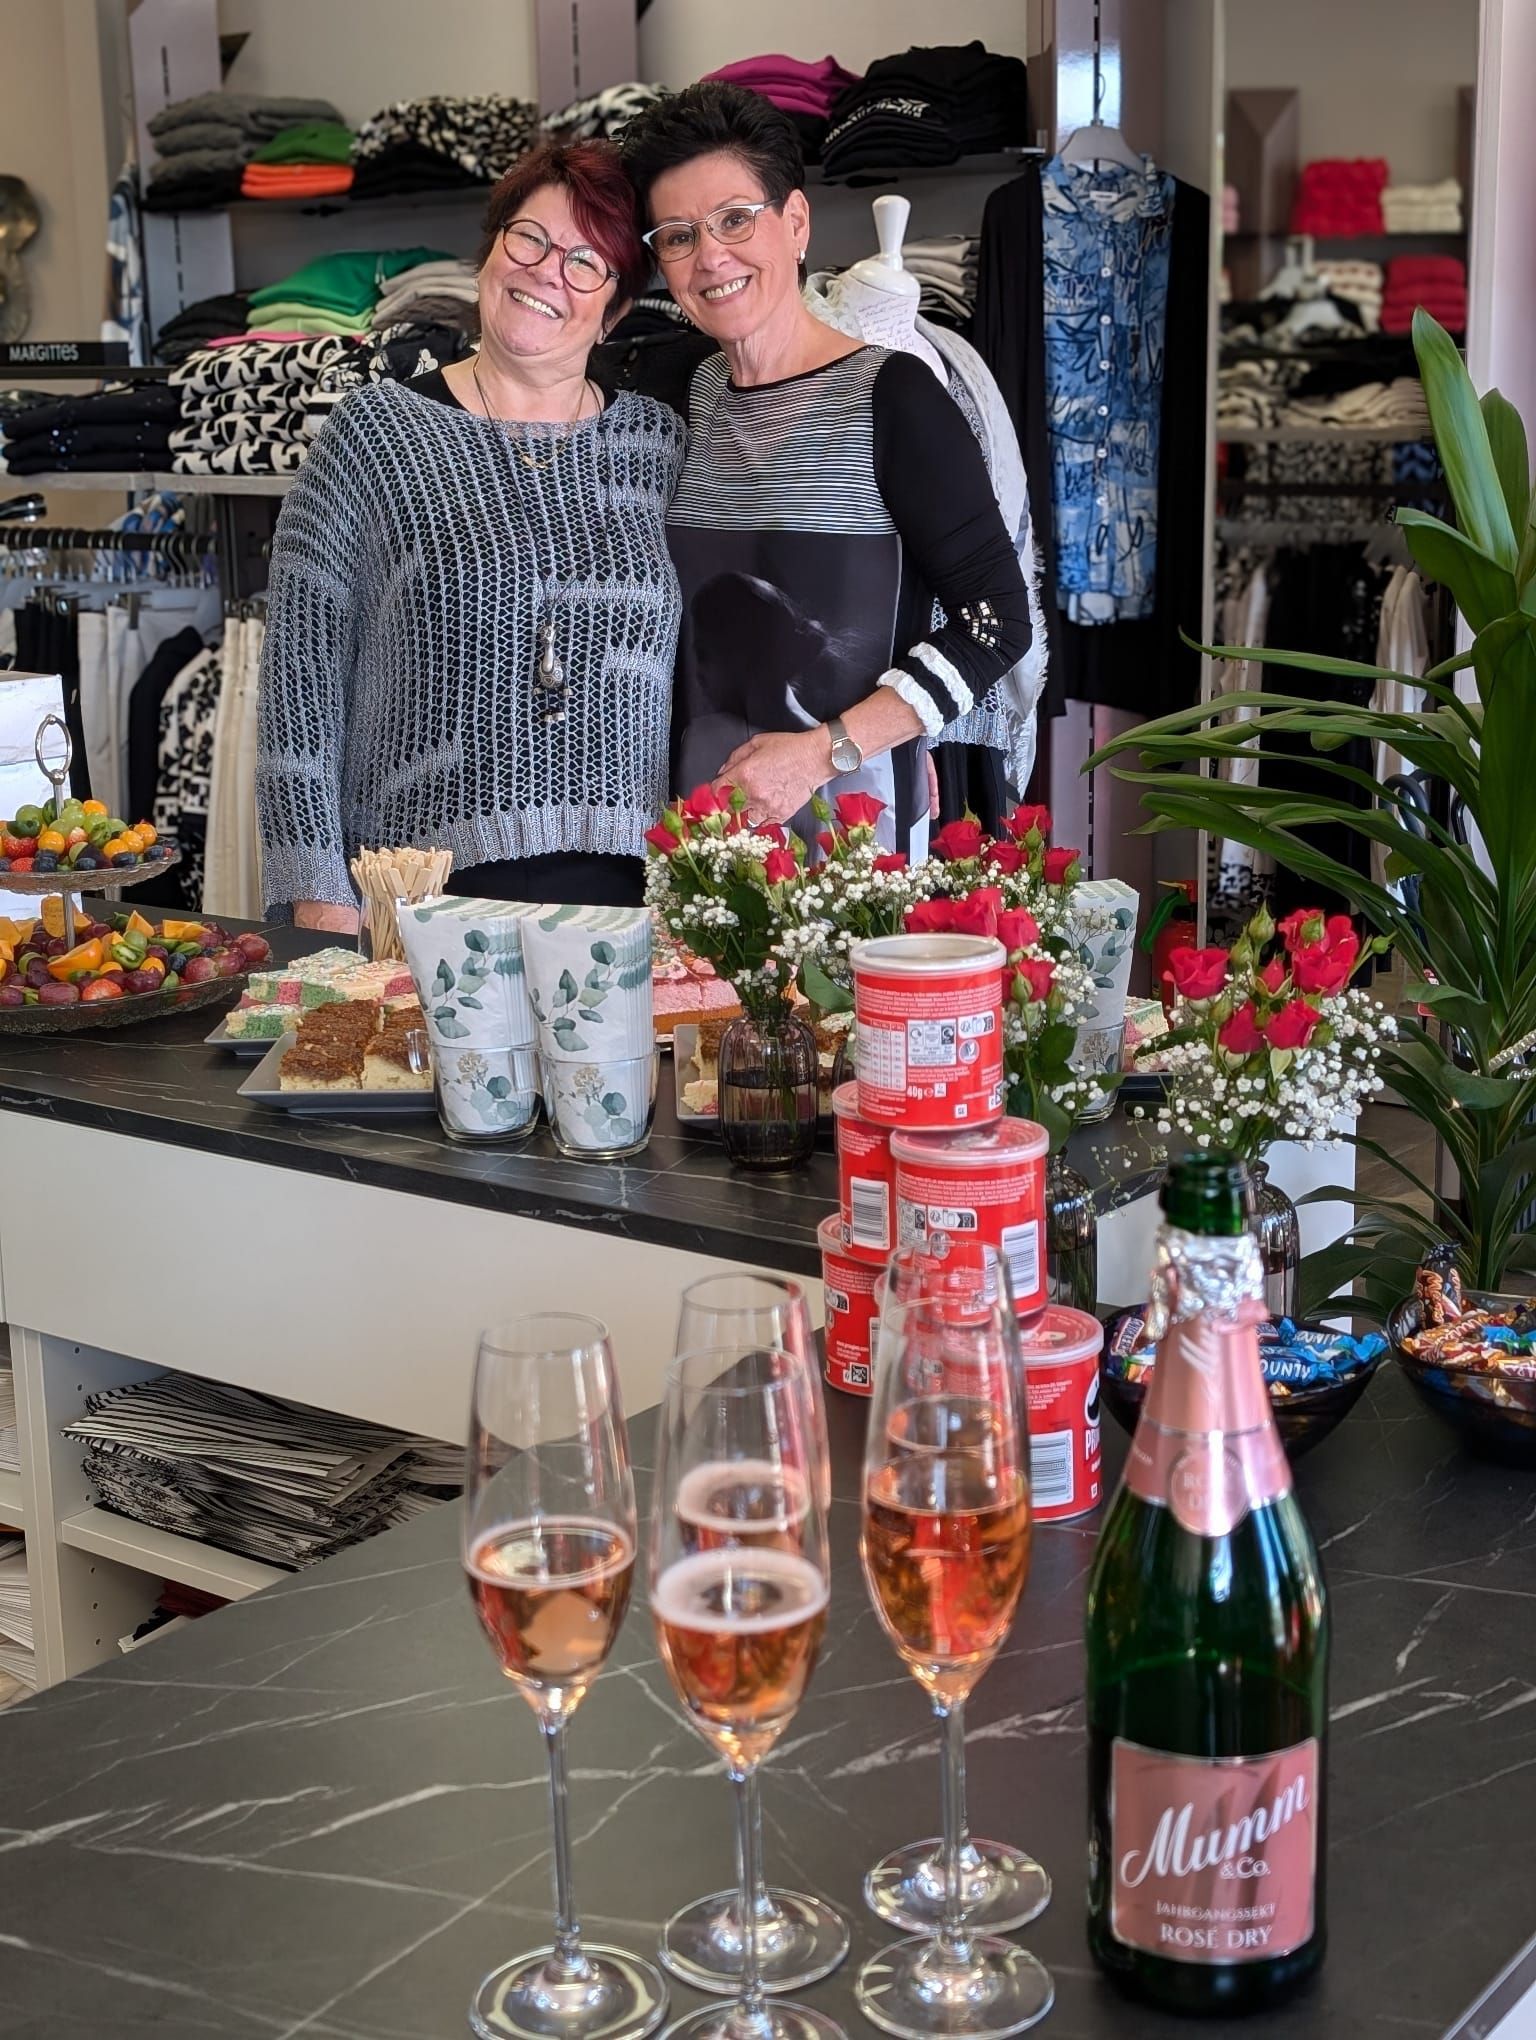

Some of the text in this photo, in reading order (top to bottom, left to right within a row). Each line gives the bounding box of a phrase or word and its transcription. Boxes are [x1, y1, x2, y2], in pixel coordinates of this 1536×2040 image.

[1259, 1359, 1311, 1379] OUNTY
[1120, 1774, 1309, 1888] Mumm
[1227, 1924, 1273, 1949] DRY
